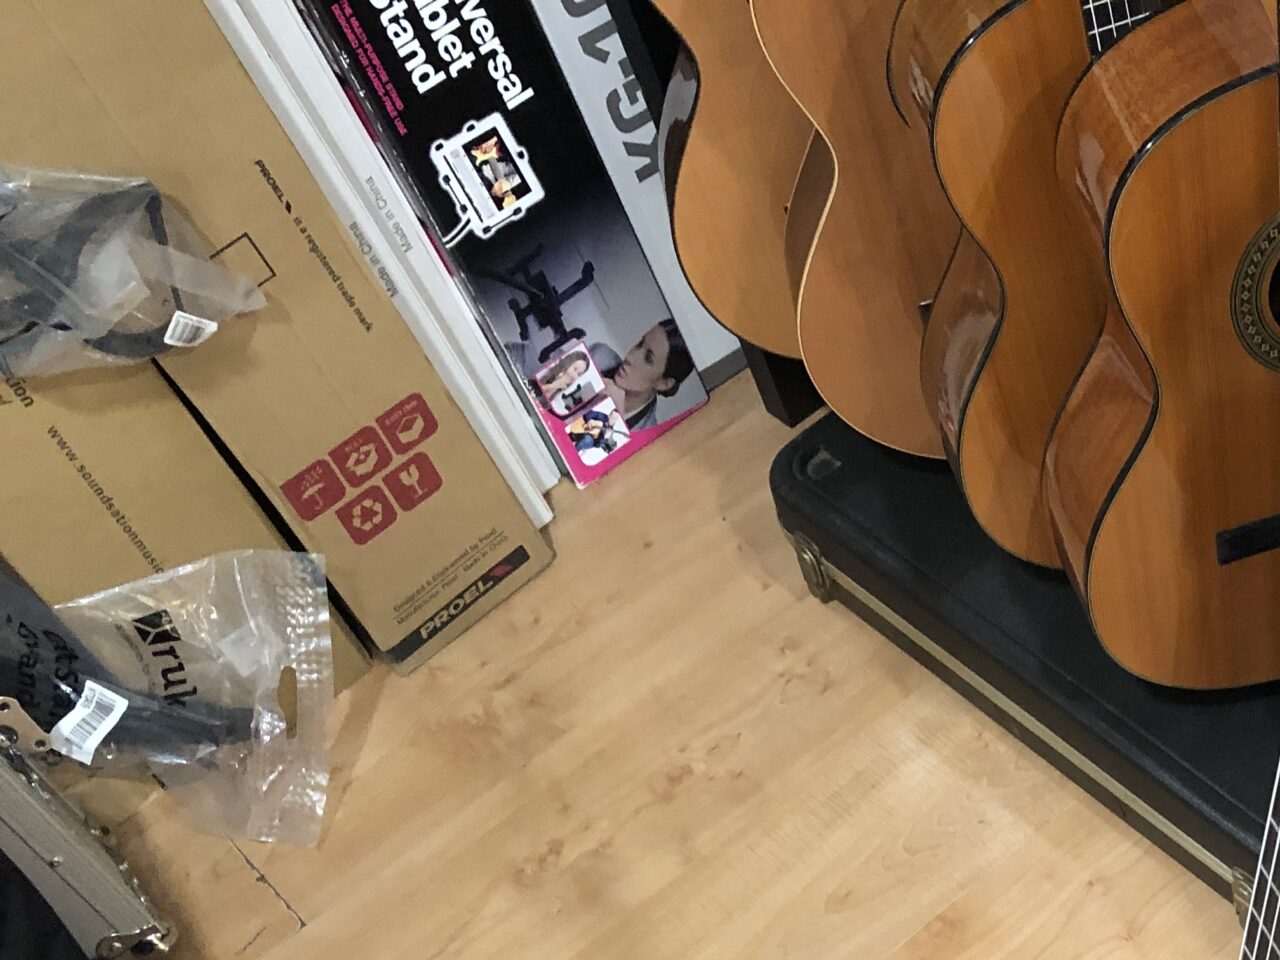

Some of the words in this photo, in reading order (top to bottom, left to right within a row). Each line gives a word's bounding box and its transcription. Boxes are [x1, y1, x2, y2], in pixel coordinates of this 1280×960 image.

[331, 3, 359, 49] DESIGNED
[355, 47, 370, 68] FOR
[365, 66, 399, 120] HANDS-FREE
[394, 116, 408, 136] USE
[350, 16, 390, 84] MULTI-PURPOSE
[385, 82, 404, 111] STAND
[454, 0, 536, 111] versal
[365, 175, 388, 211] China
[384, 208, 396, 224] in
[254, 159, 285, 203] PROEL
[304, 233, 341, 284] registered
[336, 280, 356, 308] trade
[353, 305, 374, 333] mark
[349, 221, 373, 255] China
[392, 219, 414, 254] Made
[369, 254, 381, 267] in
[378, 262, 400, 298] Made
[419, 579, 495, 640] PROEL
